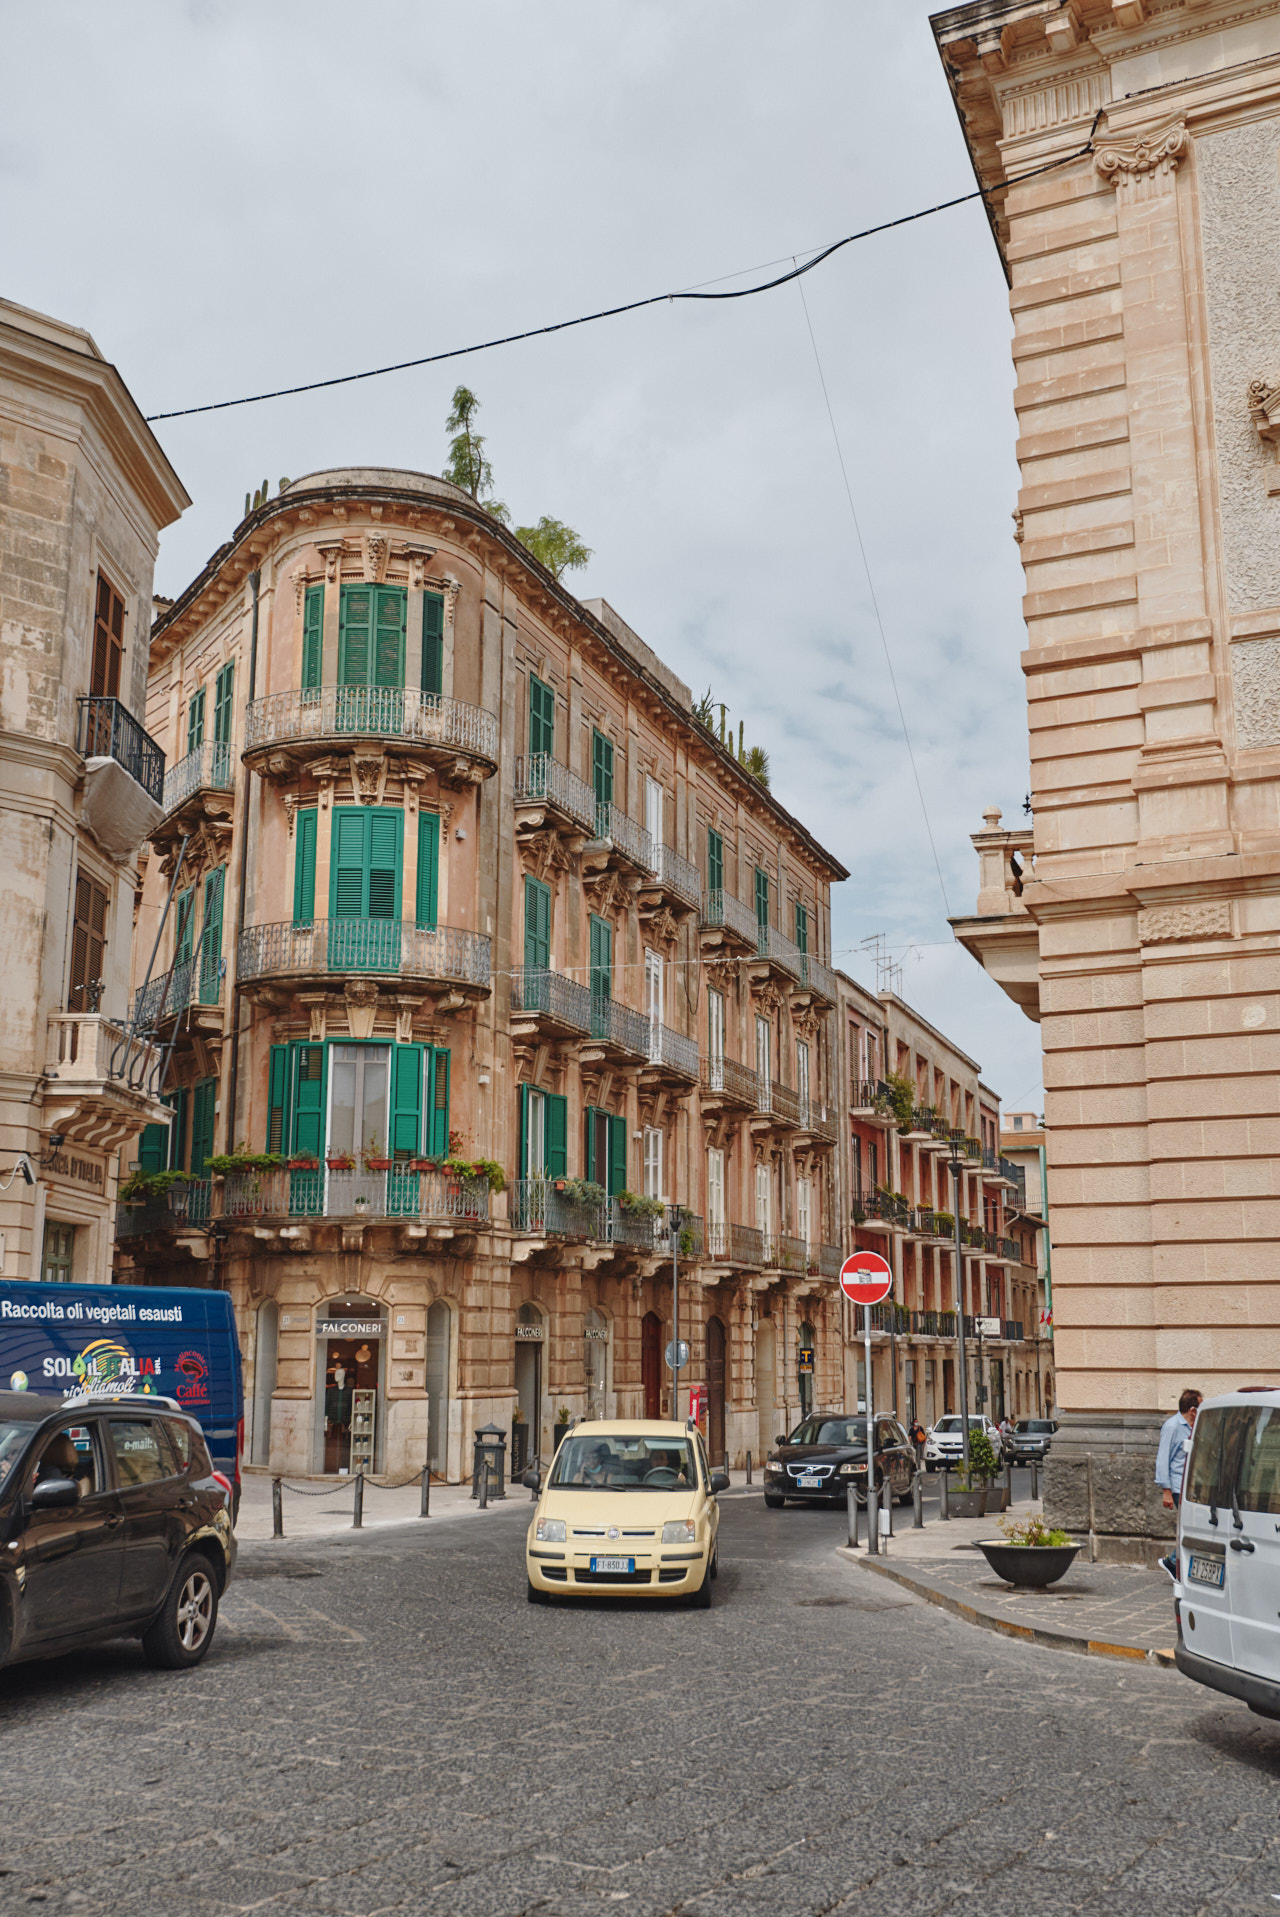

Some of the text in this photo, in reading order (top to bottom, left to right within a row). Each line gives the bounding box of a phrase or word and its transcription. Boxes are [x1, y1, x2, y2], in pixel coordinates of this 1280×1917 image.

[1, 1300, 183, 1324] Raccolta oli vegetali esausti
[322, 1323, 382, 1333] FALCONERI
[124, 1437, 154, 1451] e-mail:
